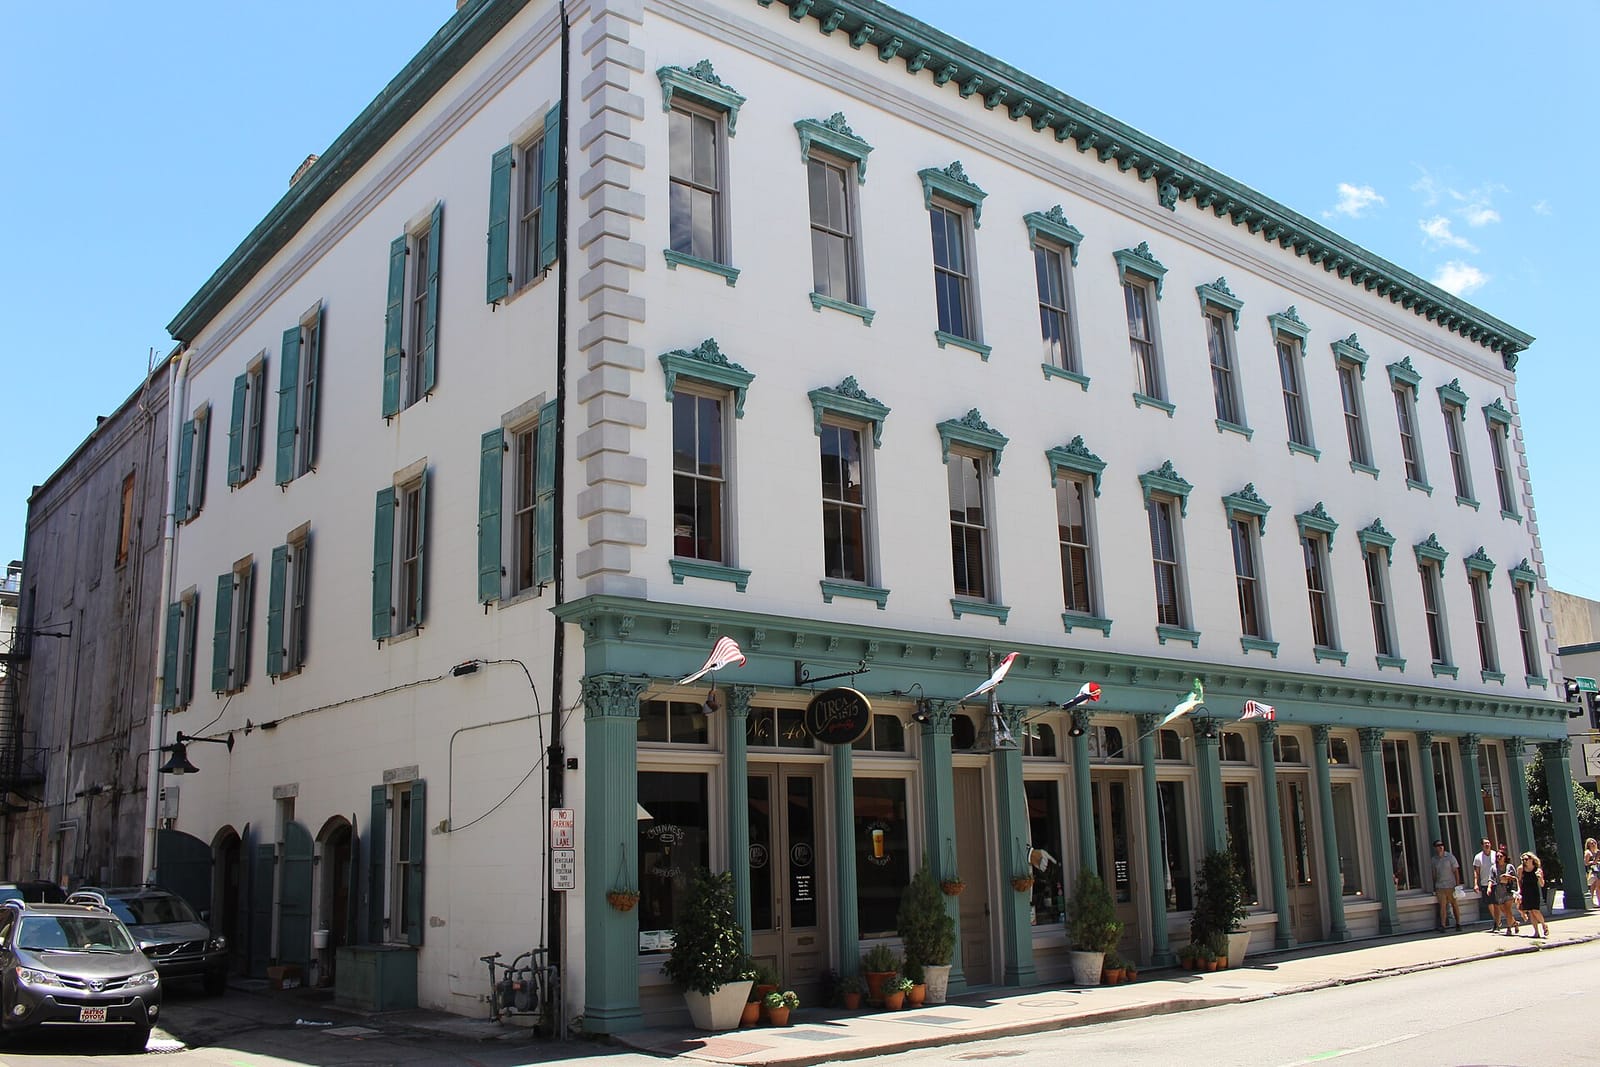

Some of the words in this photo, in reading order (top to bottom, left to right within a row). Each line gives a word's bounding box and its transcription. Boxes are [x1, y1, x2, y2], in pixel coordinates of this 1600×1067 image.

[815, 698, 847, 734] CIRCA
[559, 811, 567, 819] NO
[552, 820, 573, 828] PARKING
[647, 823, 686, 840] GUINNESS
[556, 838, 570, 846] LANE
